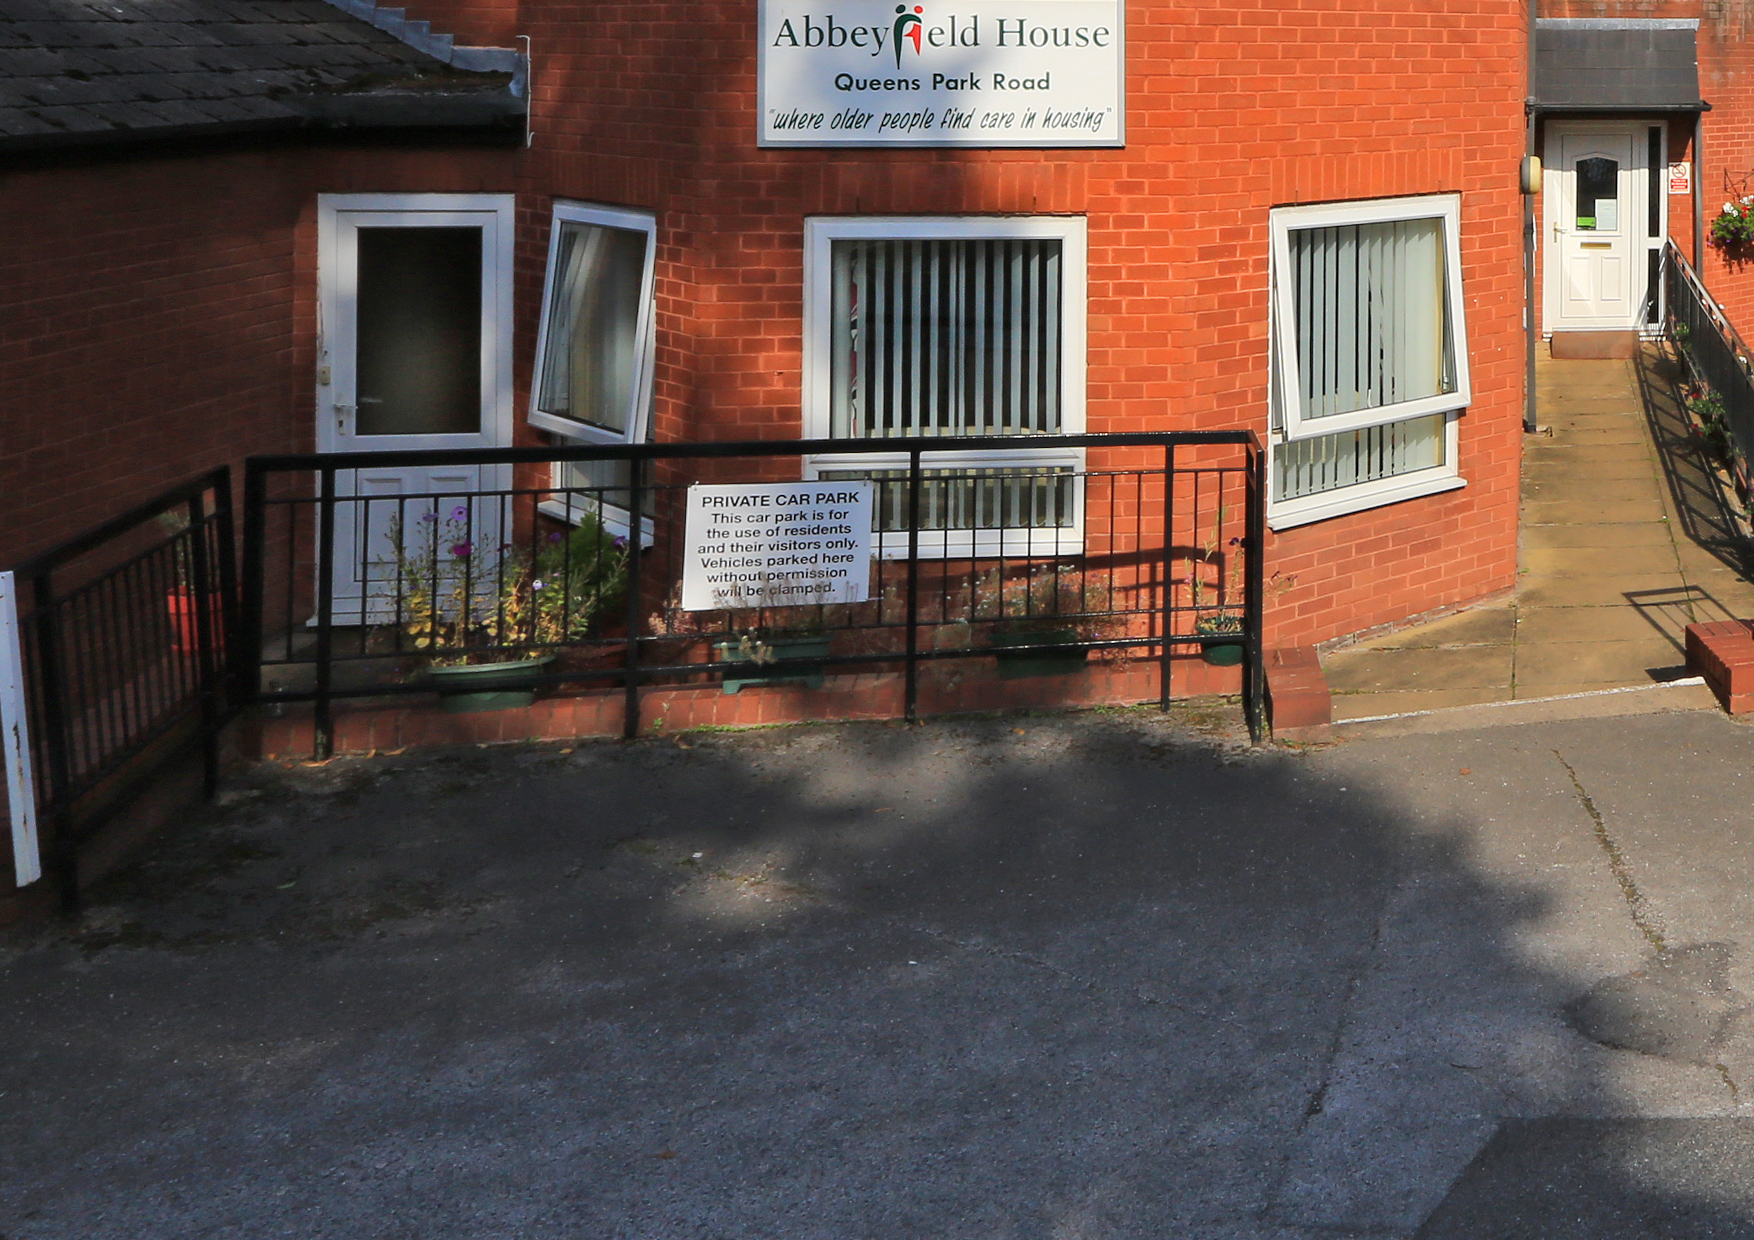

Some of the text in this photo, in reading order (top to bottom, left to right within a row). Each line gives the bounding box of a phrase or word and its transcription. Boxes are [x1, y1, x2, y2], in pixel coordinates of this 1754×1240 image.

[772, 4, 1110, 70] Abbeyfield House
[834, 71, 1051, 92] Queens Park Road
[830, 108, 873, 130] older
[878, 108, 934, 134] people
[940, 108, 975, 130] find
[979, 111, 1014, 129] care
[1020, 108, 1035, 129] in
[701, 491, 860, 508] PRIVATE CAR PARK
[711, 509, 849, 525] This car park is for
[706, 524, 852, 539] the use of residents
[698, 538, 859, 554] and their visitors only.
[701, 553, 854, 569] Vehicles parked here
[706, 567, 847, 583] without permission
[717, 585, 741, 597] will
[746, 585, 763, 596] be
